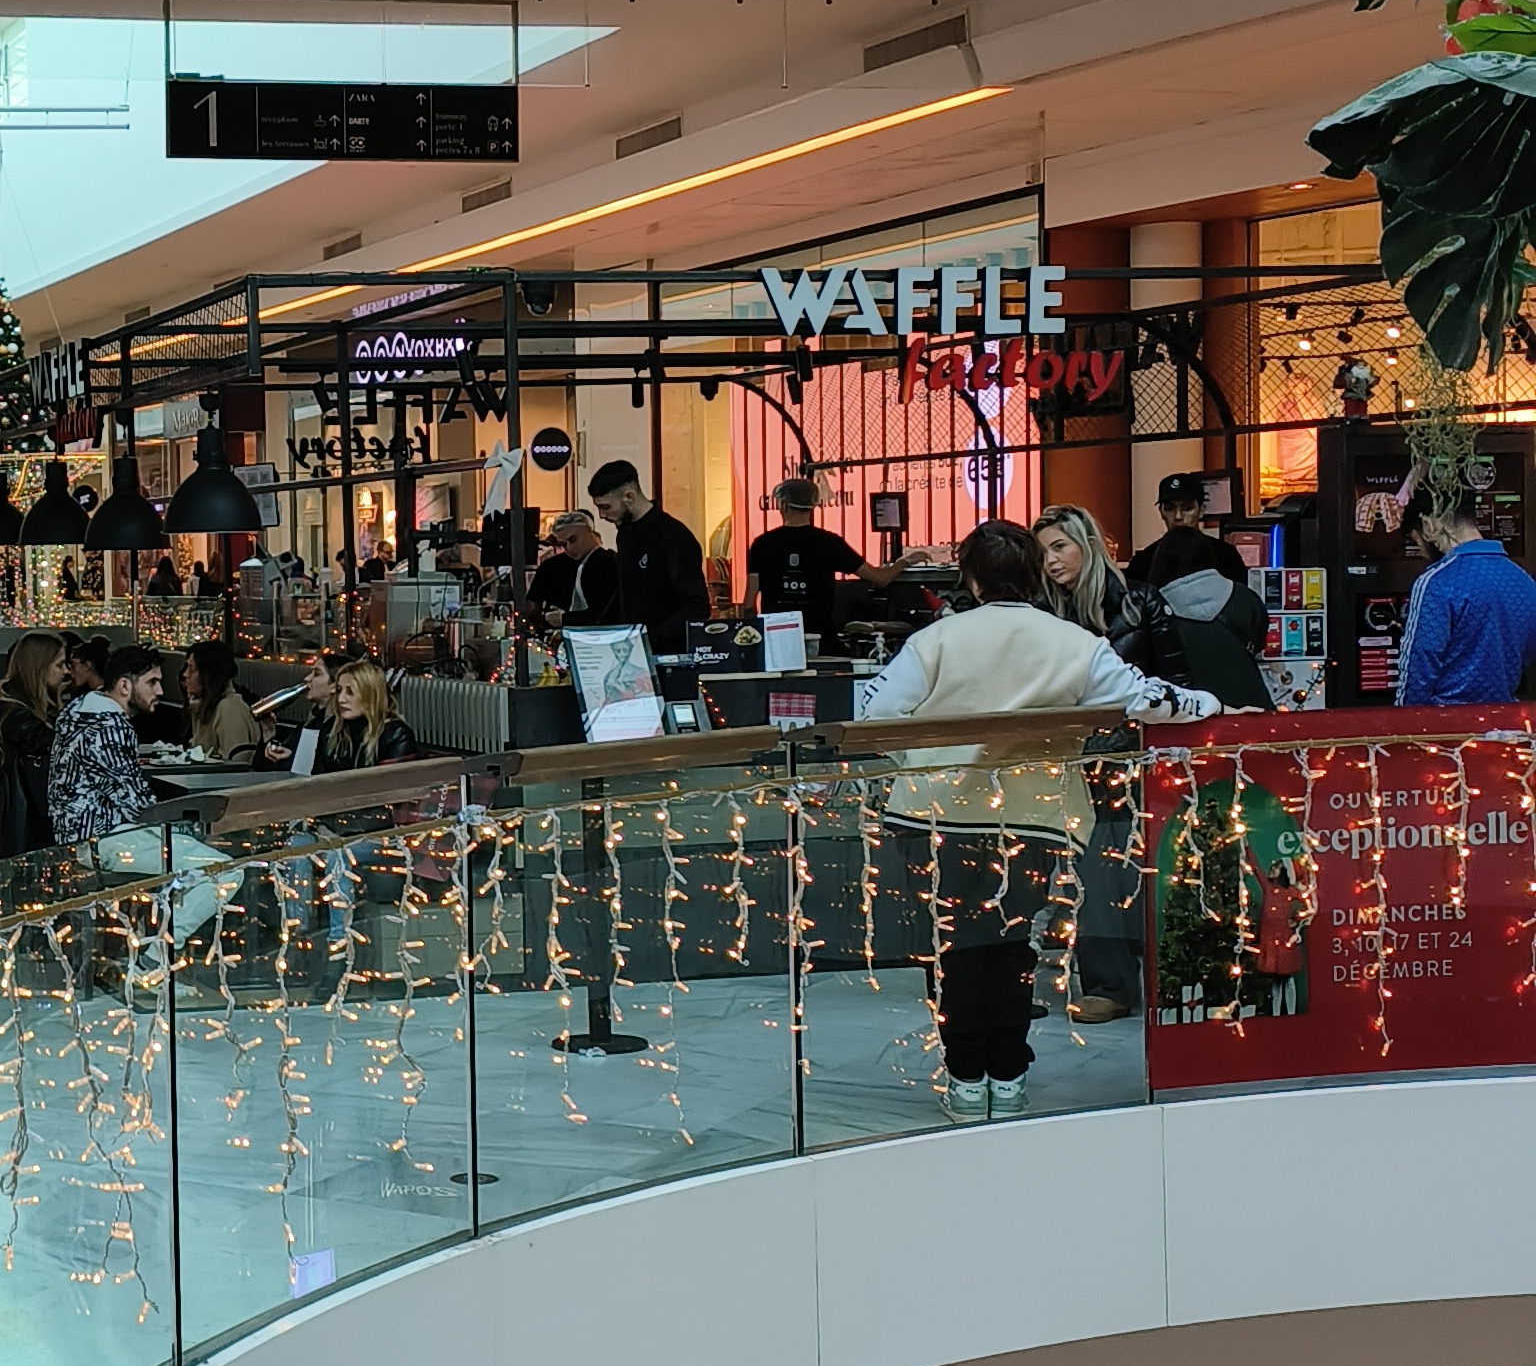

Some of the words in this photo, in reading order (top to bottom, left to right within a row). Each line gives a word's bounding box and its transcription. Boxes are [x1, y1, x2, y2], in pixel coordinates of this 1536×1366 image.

[348, 93, 376, 103] ZARA
[193, 90, 218, 148] 1
[760, 266, 1066, 336] WAFFLE
[28, 338, 85, 409] WAFFLE
[898, 337, 1122, 404] factory
[1329, 789, 1469, 810] OUVERTUR
[1332, 904, 1467, 926] DIMANCHES
[1332, 937, 1349, 956] 3,
[1418, 932, 1442, 950] ET
[1449, 930, 1473, 948] 24
[1333, 959, 1454, 982] DÉCEMBRE
